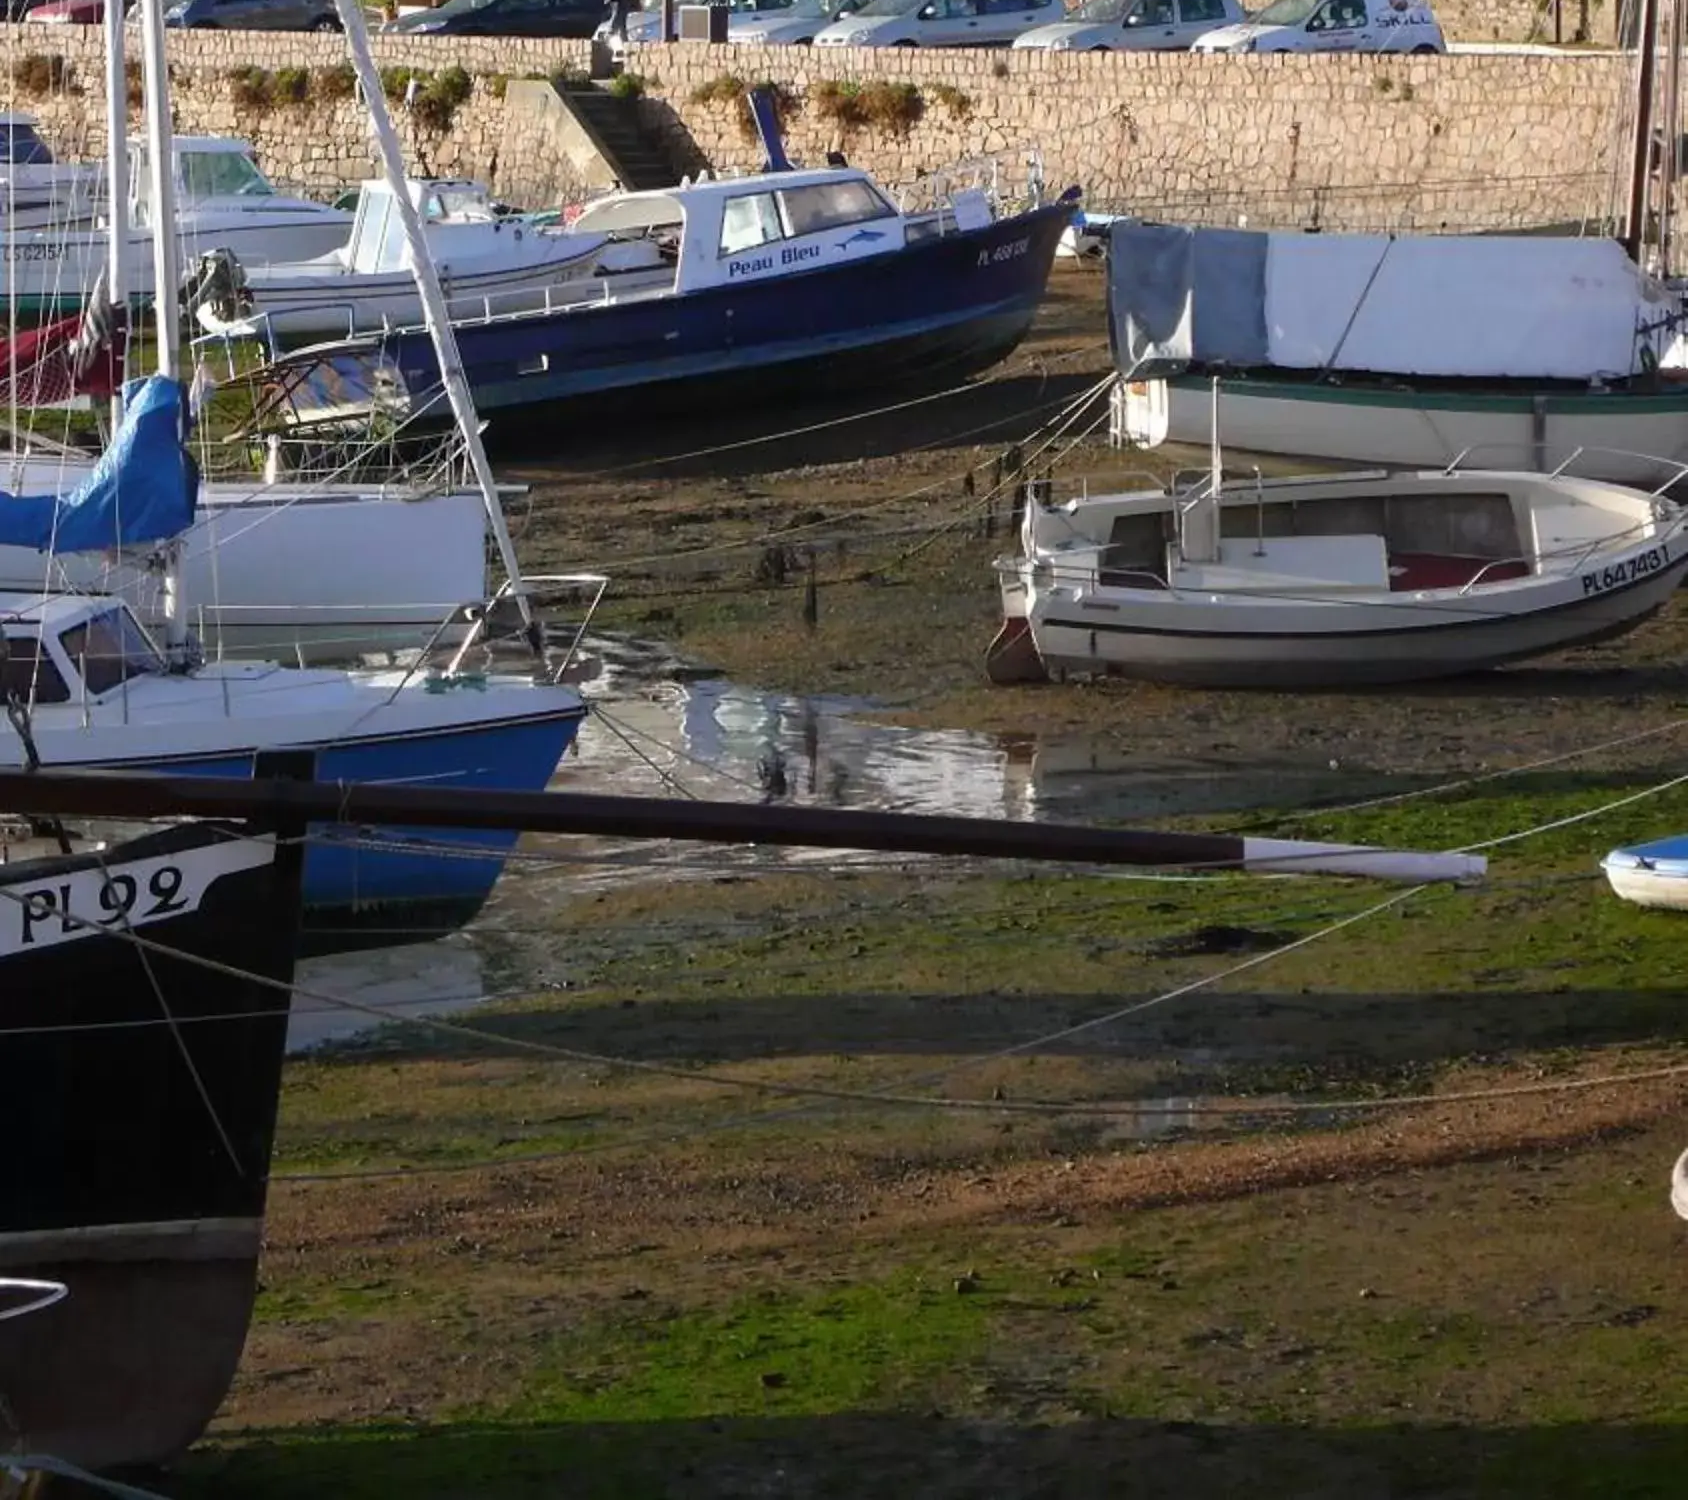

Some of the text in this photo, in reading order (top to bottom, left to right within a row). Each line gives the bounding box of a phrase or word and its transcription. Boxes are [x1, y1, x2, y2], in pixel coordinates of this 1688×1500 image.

[729, 245, 820, 277] Peau Bleu
[22, 866, 190, 944] PL 92
